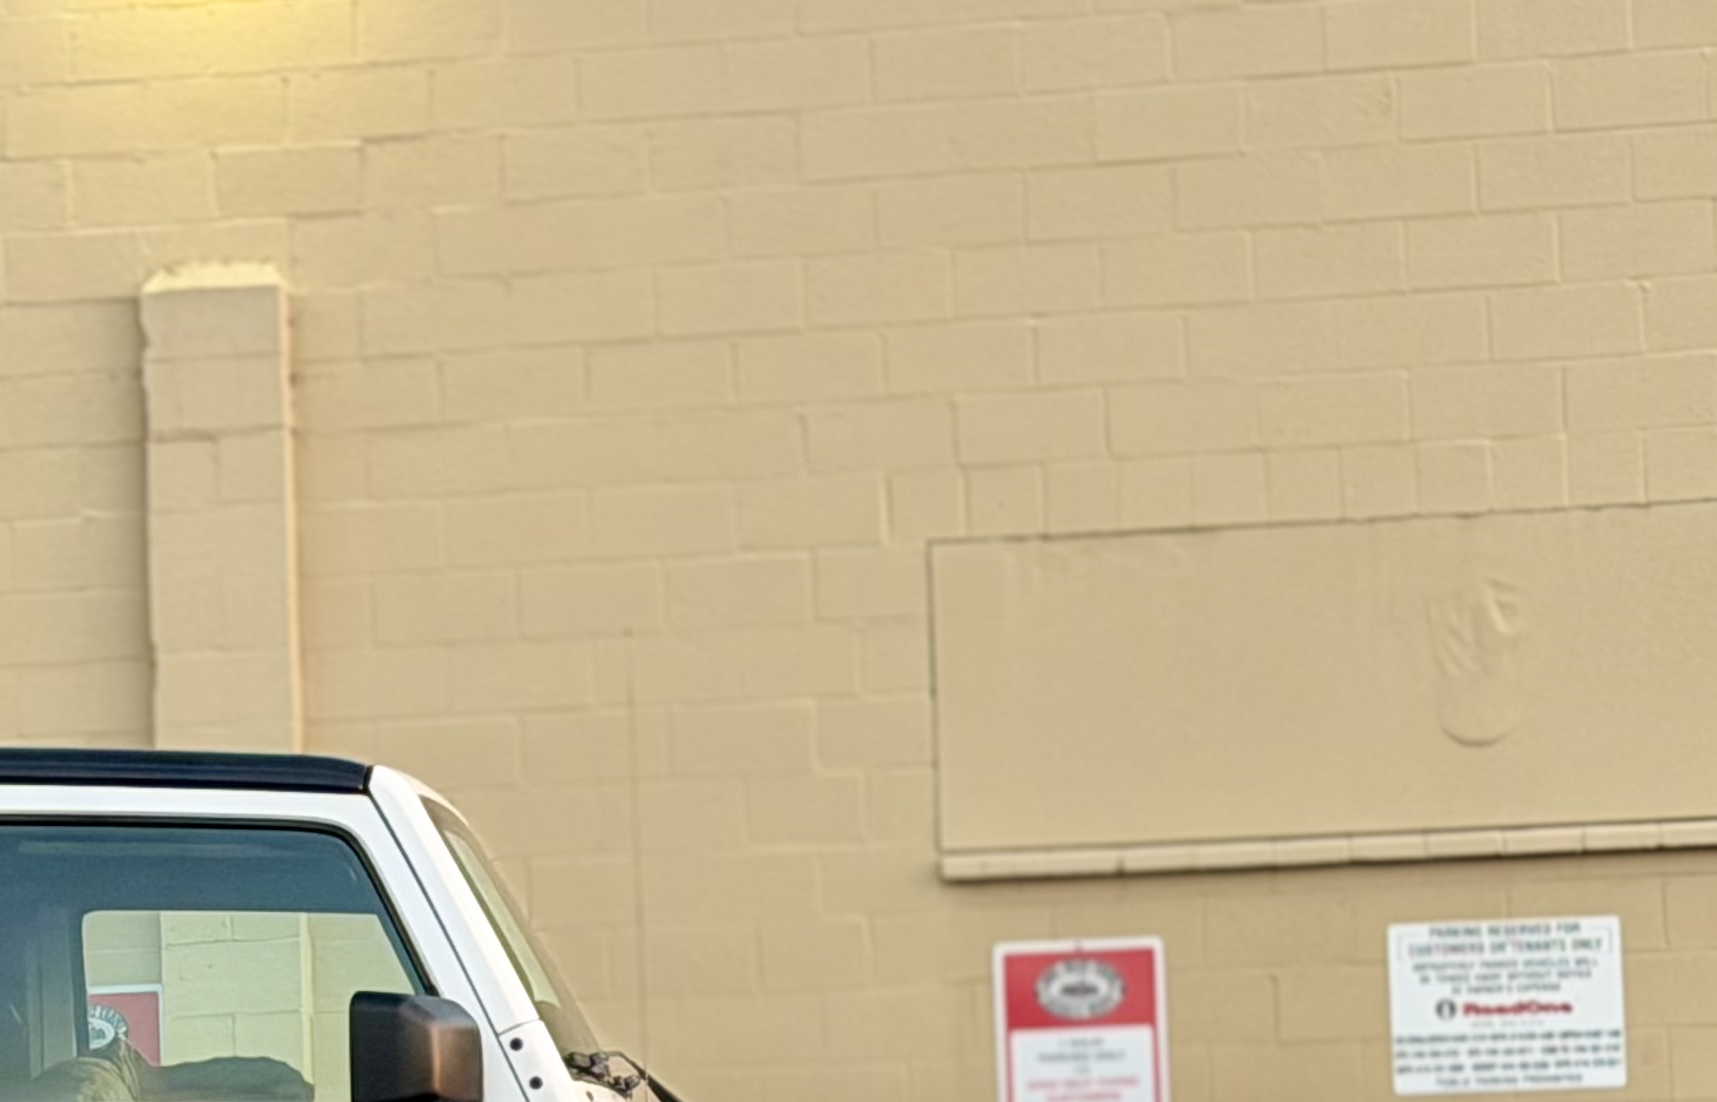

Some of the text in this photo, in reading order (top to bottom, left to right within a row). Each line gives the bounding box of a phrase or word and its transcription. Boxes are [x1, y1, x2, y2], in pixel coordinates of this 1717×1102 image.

[1430, 925, 1481, 937] PARKING
[1487, 923, 1551, 936] RESERVED
[1408, 943, 1484, 957] CUSTOMERS
[1571, 938, 1602, 951] ONLY
[1463, 1000, 1573, 1017] RoadOne
